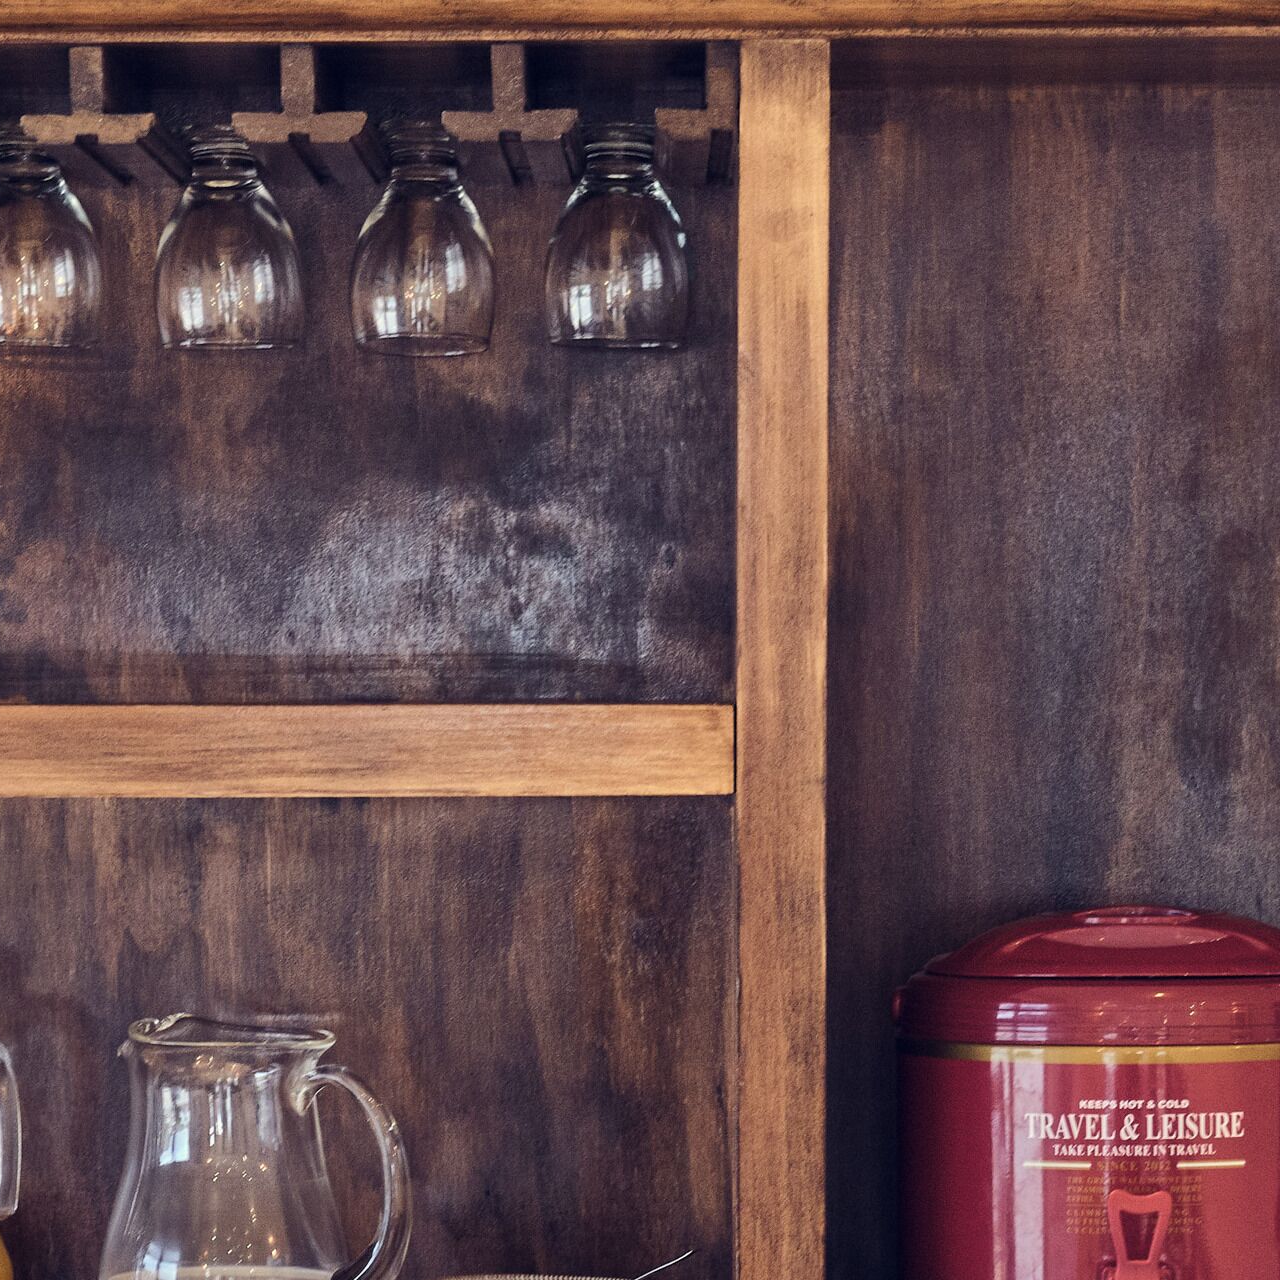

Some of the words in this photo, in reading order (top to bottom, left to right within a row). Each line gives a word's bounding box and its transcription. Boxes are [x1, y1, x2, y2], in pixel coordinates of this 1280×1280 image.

[1078, 1099, 1117, 1110] KEEPS
[1119, 1099, 1144, 1110] HOT
[1157, 1099, 1190, 1109] COLD
[1024, 1112, 1116, 1140] TRAVEL
[1120, 1112, 1140, 1140] &
[1145, 1111, 1245, 1140] LEISURE
[1052, 1144, 1085, 1156] TAKE
[1086, 1144, 1153, 1157] PLEASURE
[1153, 1144, 1168, 1156] IN
[1168, 1143, 1216, 1156] TRAVEL
